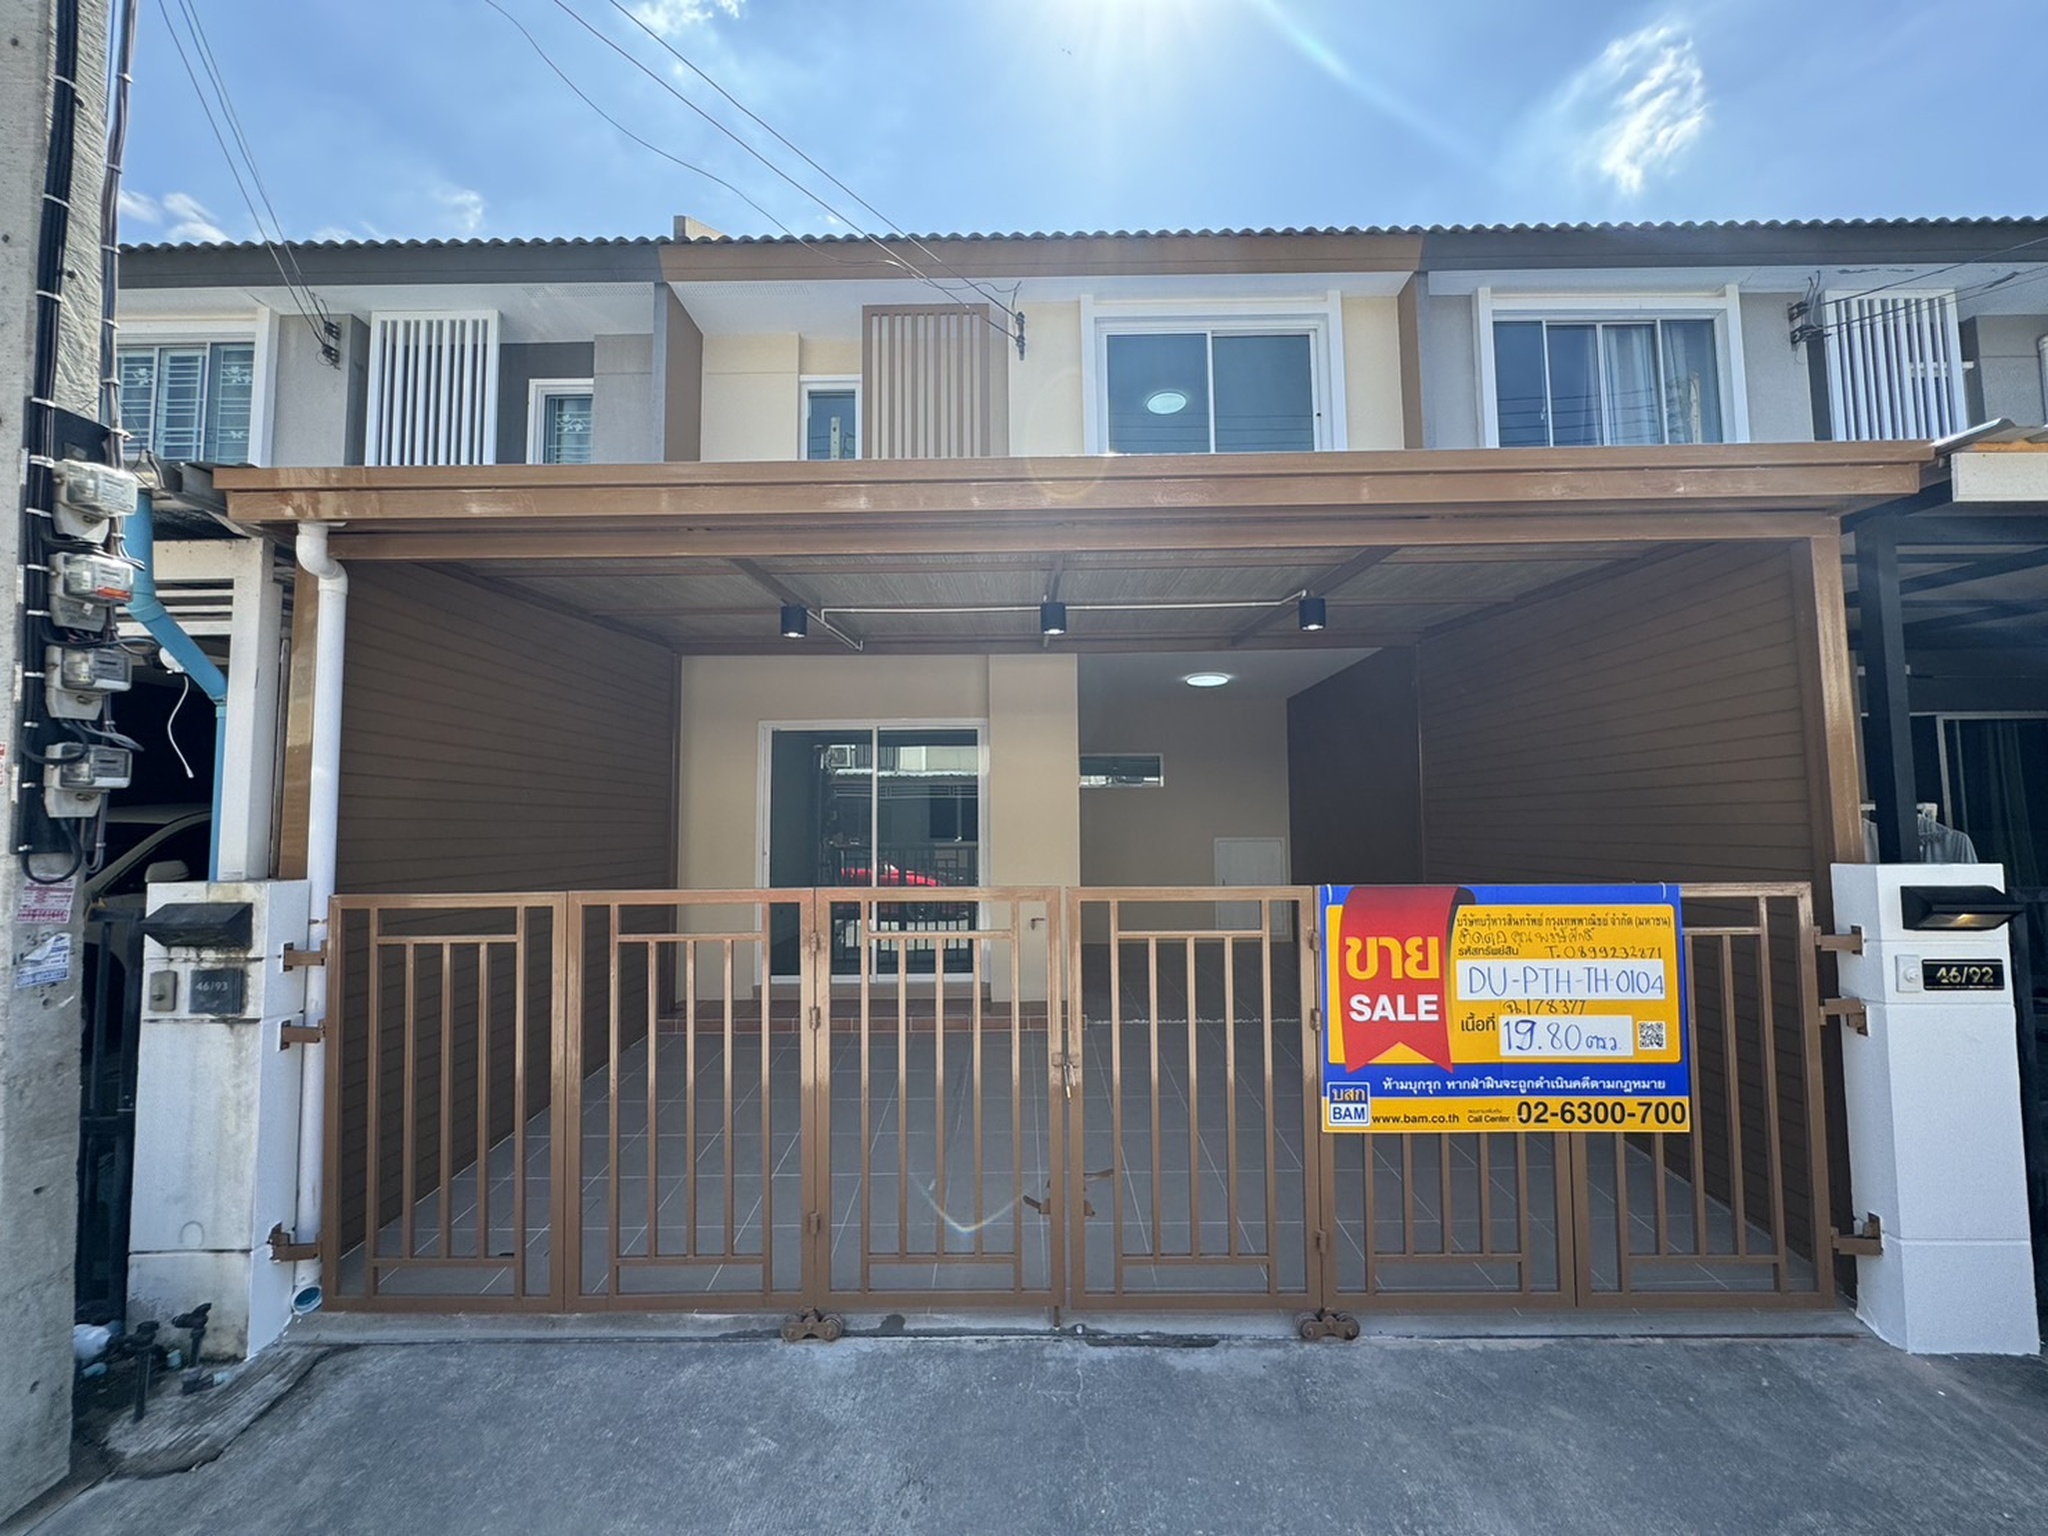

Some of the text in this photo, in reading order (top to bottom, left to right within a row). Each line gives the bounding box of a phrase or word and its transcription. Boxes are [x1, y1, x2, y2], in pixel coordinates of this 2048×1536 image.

[1345, 936, 1440, 980] ขาย
[1936, 966, 1994, 984] 46/92
[1348, 994, 1440, 1022] SALE
[1461, 1012, 1496, 1032] เนื้อที่
[1503, 1019, 1582, 1051] 19.80
[1332, 1086, 1366, 1102] บสก
[1382, 1077, 1441, 1095] ห้ามบุกรุก
[1332, 1106, 1366, 1120] BAM
[1372, 1113, 1460, 1124] www.bam.co.th
[1467, 1115, 1510, 1123] Call Center
[1517, 1101, 1687, 1124] 02-6300-700
